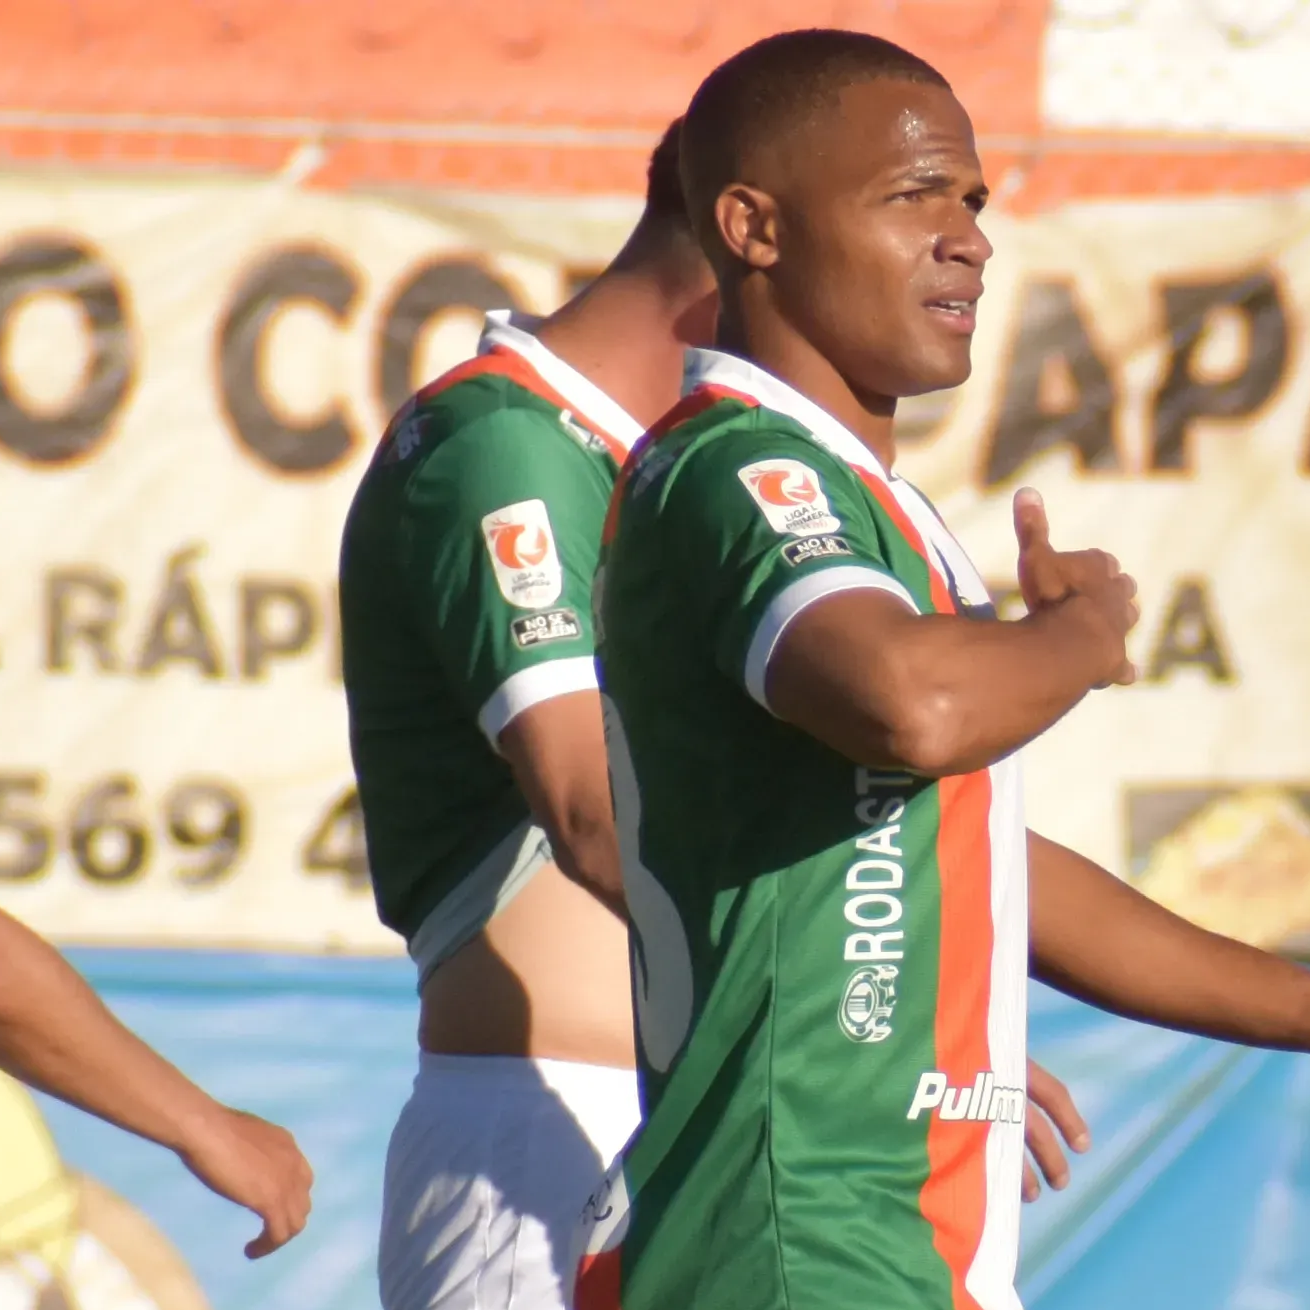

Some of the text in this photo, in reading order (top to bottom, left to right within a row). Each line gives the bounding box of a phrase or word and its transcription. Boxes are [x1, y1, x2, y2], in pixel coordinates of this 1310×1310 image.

[212, 238, 602, 482] CO
[42, 542, 344, 682] RÁP
[525, 615, 547, 630] NO
